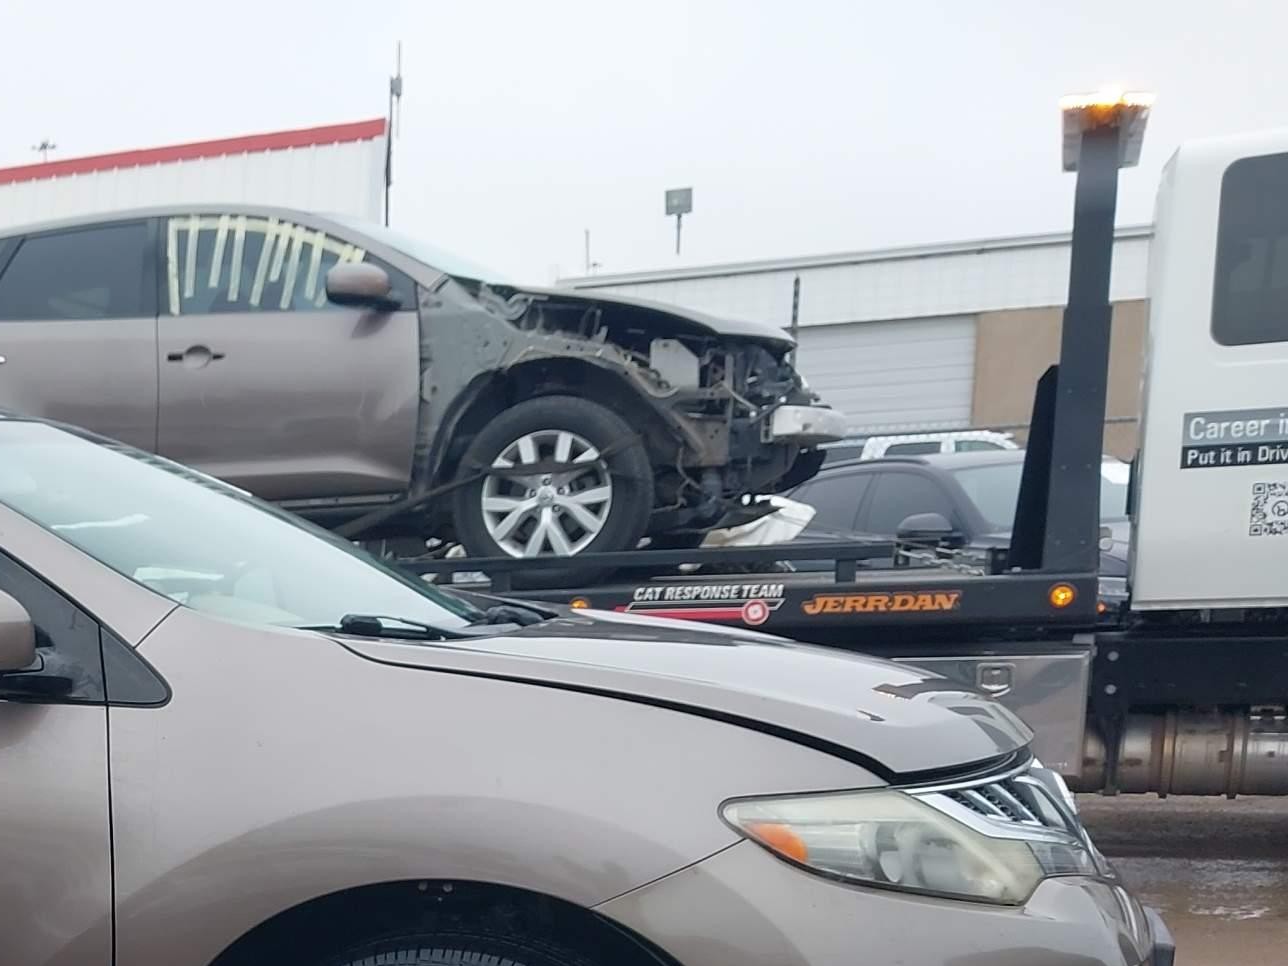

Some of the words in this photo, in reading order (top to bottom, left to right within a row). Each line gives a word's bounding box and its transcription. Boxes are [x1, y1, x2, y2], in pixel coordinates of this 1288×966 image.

[1189, 417, 1270, 440] Career
[1186, 449, 1216, 466] Put
[1220, 447, 1233, 465] it
[1237, 446, 1252, 464] in
[633, 587, 665, 601] CAT
[664, 585, 741, 600] RESPONSE
[741, 583, 785, 599] TEAM
